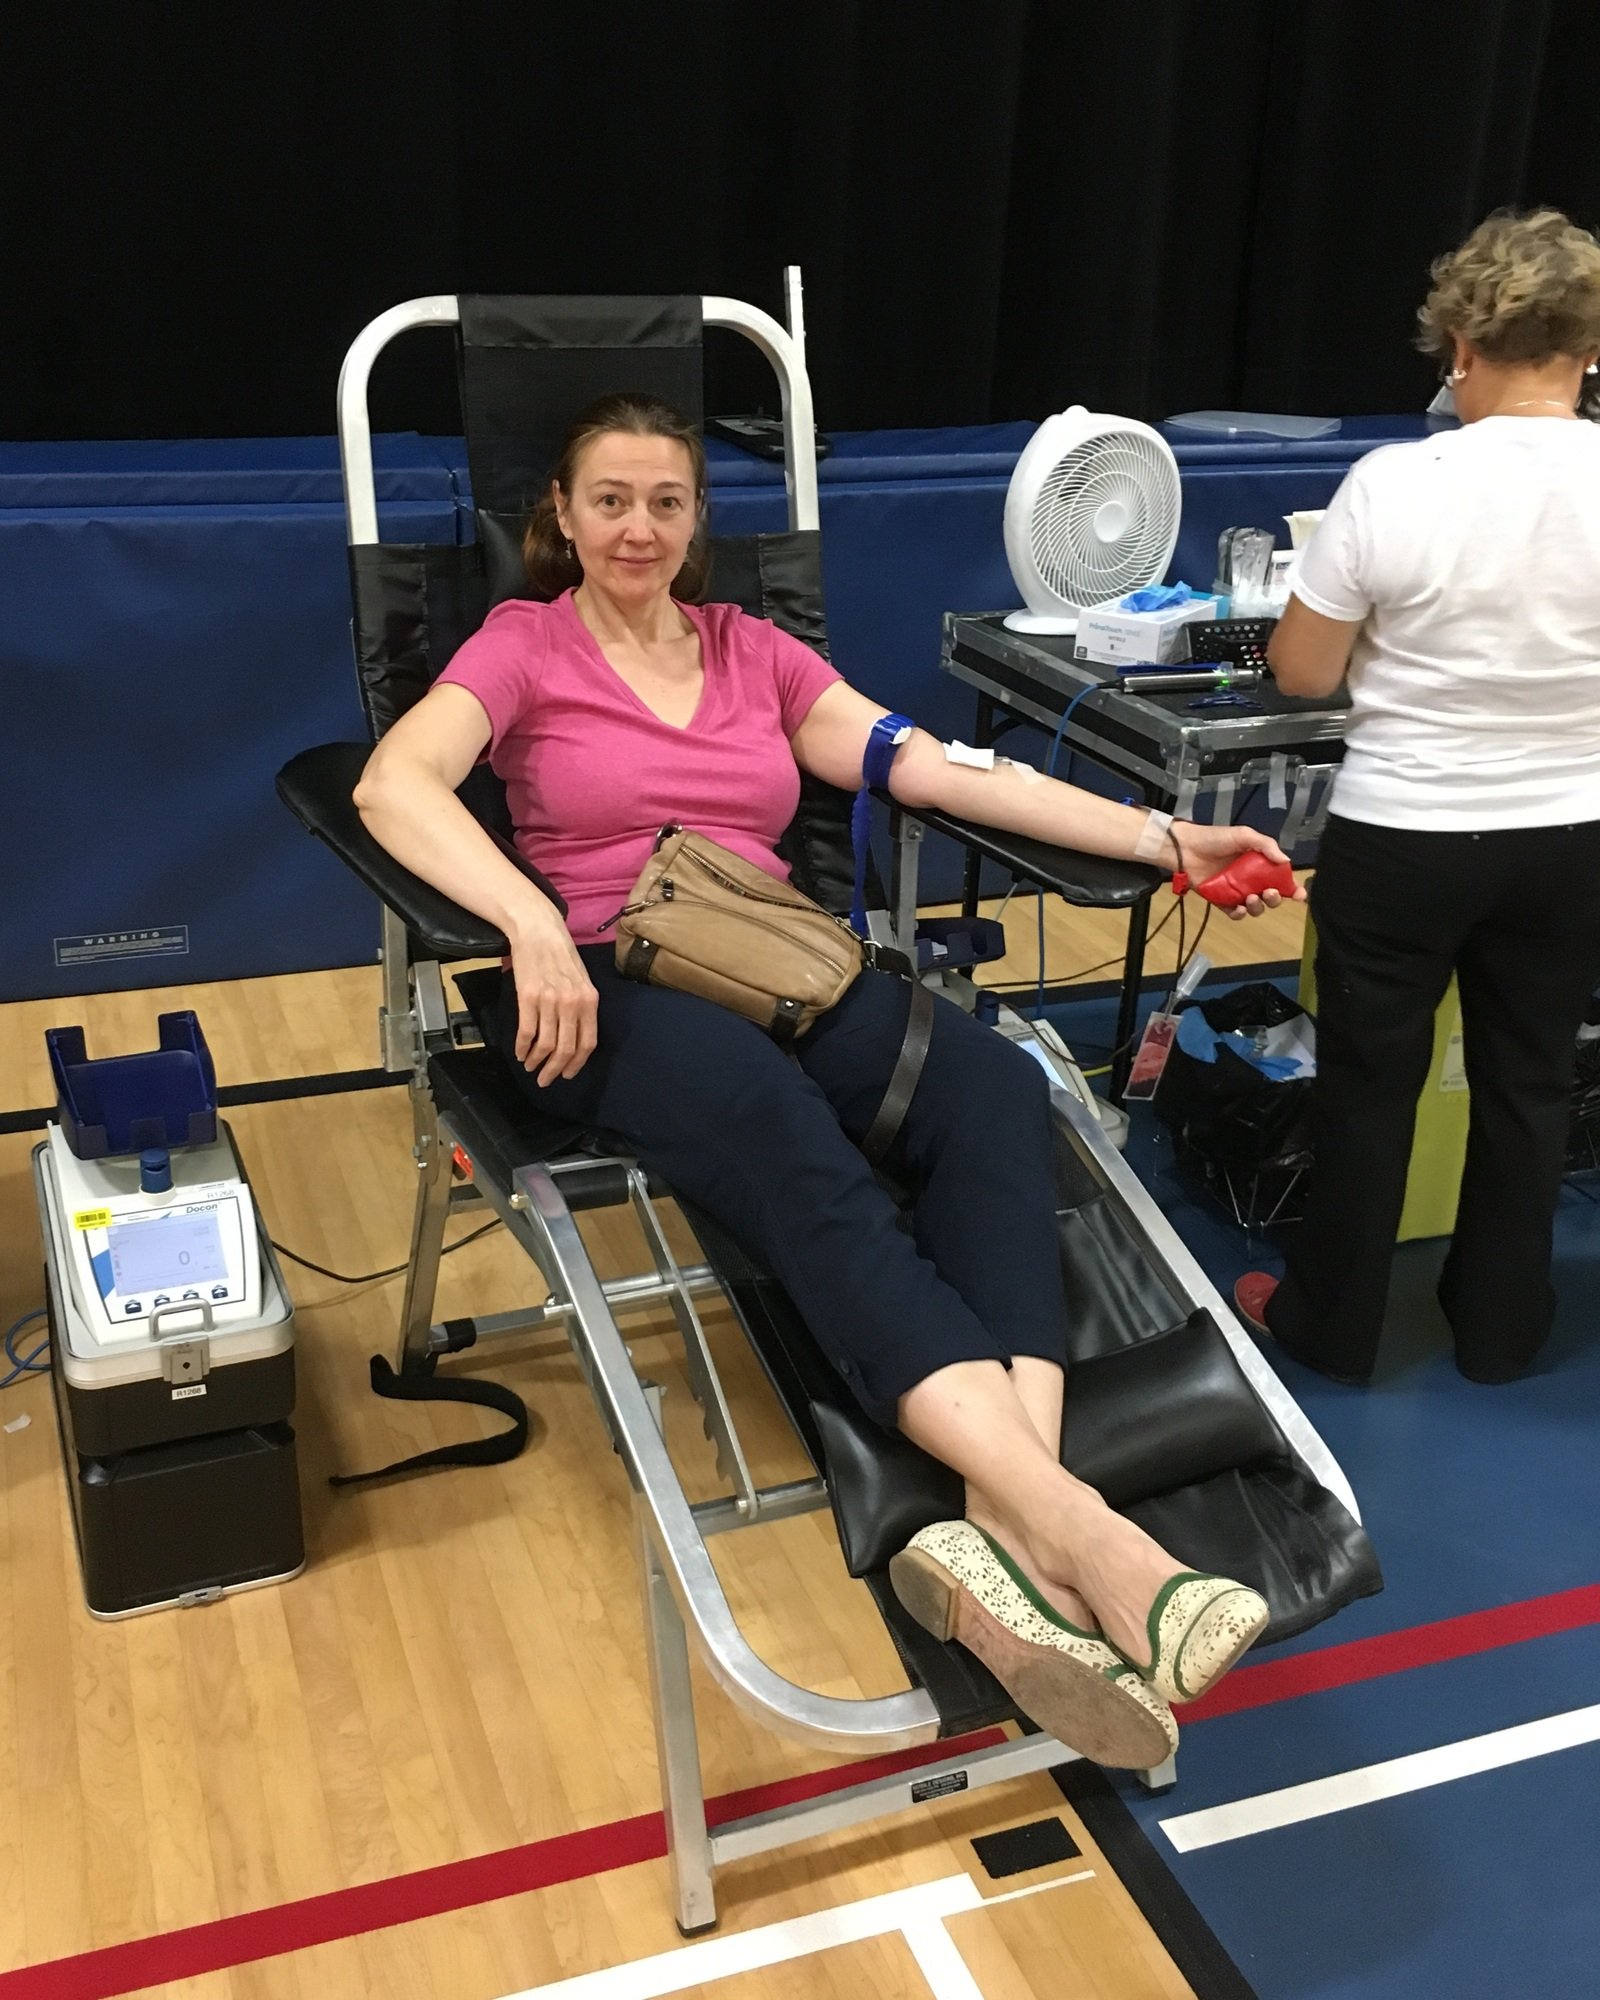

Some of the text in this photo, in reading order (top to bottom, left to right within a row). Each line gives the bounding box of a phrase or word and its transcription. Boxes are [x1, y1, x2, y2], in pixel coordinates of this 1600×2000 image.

[84, 931, 159, 945] WARNING
[207, 1190, 235, 1199] R1268
[186, 1203, 218, 1214] Docon
[176, 1387, 202, 1398] R1268
